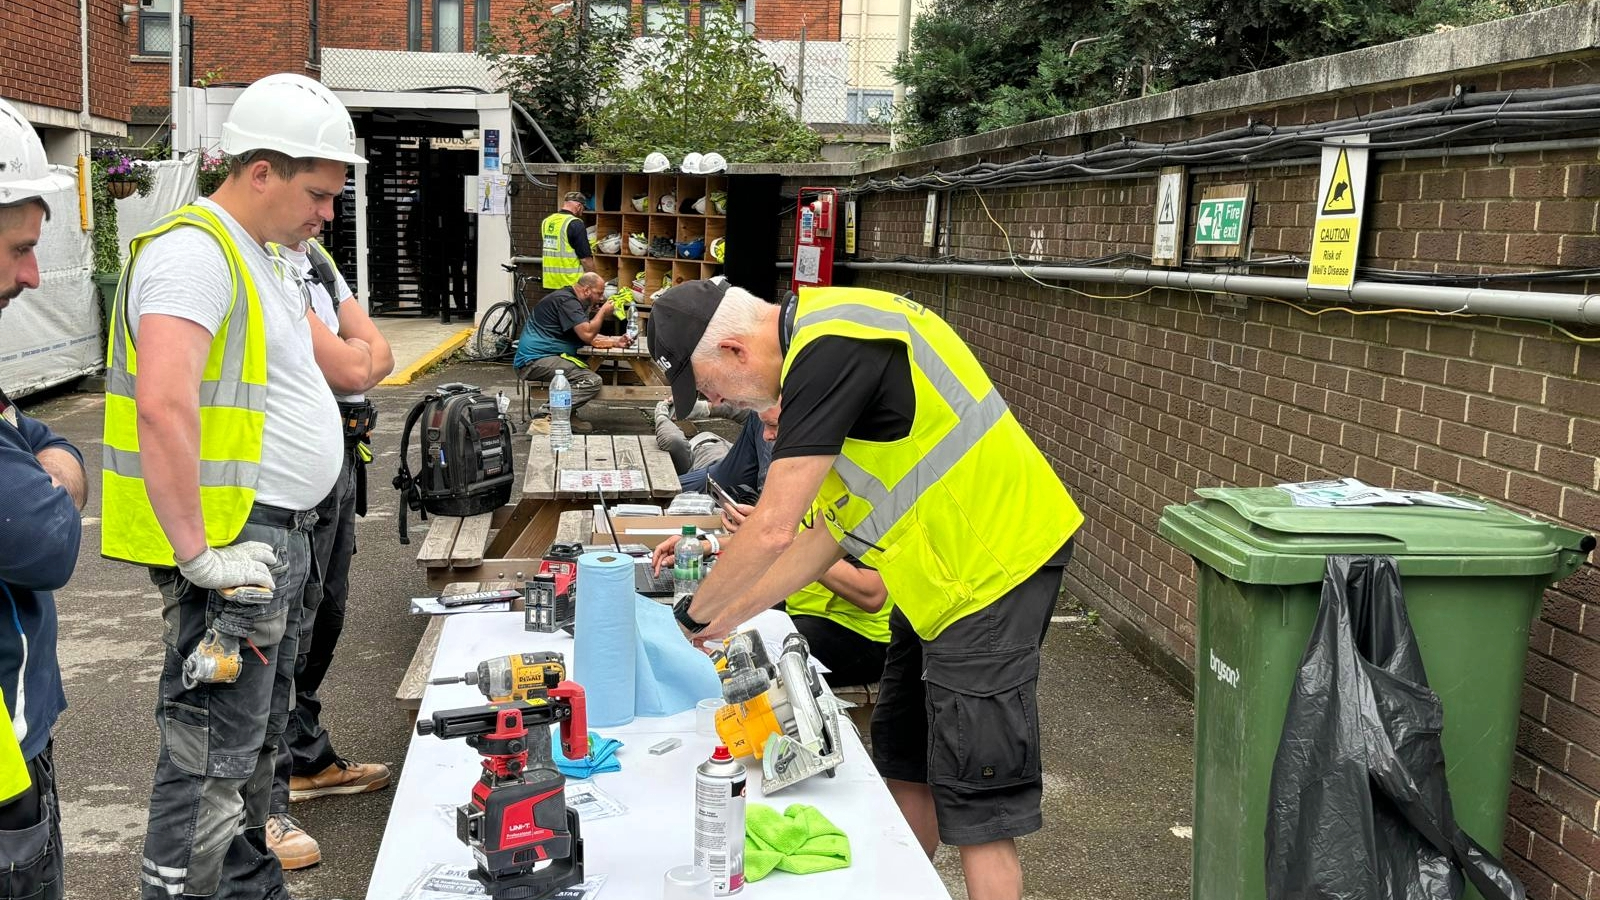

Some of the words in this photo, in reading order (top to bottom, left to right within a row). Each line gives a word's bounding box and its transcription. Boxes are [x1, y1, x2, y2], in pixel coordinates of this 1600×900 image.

[1226, 204, 1240, 220] Fire
[1223, 223, 1237, 238] exit
[1320, 228, 1350, 240] CAUTION
[1323, 250, 1334, 260] Risk
[1335, 250, 1342, 260] of
[1327, 266, 1349, 276] Disease
